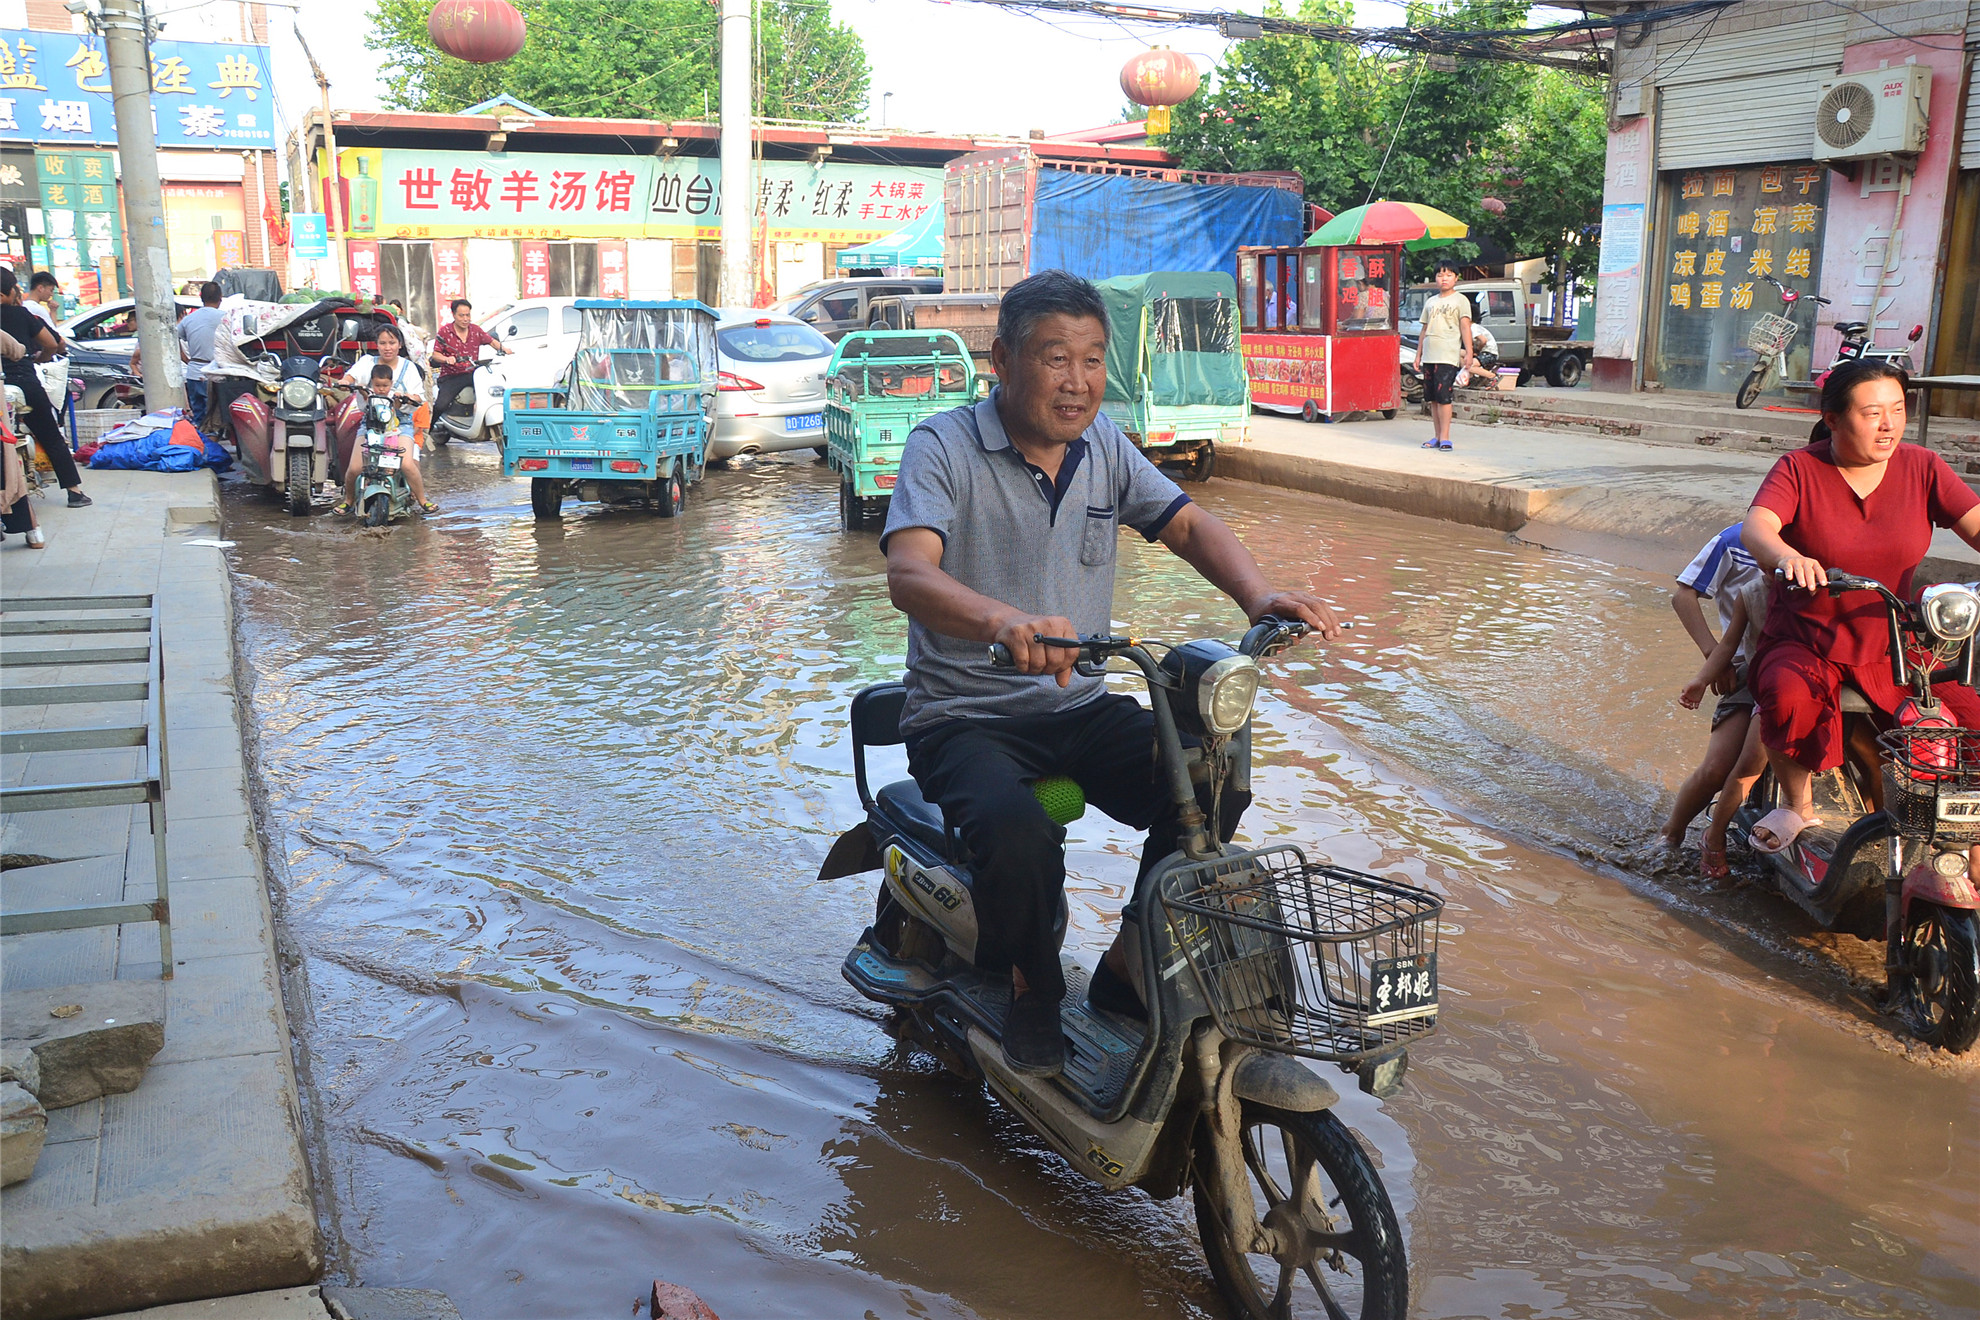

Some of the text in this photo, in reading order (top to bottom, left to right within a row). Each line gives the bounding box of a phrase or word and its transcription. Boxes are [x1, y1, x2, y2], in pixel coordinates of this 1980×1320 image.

[1883, 80, 1904, 91] AUX
[1613, 130, 1640, 189] 啤酒
[398, 167, 636, 213] 世敏羊汤馆
[651, 173, 723, 217] 丛台
[868, 180, 927, 200] 大锅菜
[1760, 165, 1821, 195] 包子
[1677, 203, 1816, 240] 啤酒 凉菜
[525, 250, 548, 295] 羊汤
[1342, 258, 1385, 278] 香酥
[1672, 247, 1812, 279] 凉皮 米线
[1342, 287, 1383, 306] 鸡腿
[1669, 282, 1754, 311] 鸡蛋汤
[1396, 960, 1414, 969] SBN
